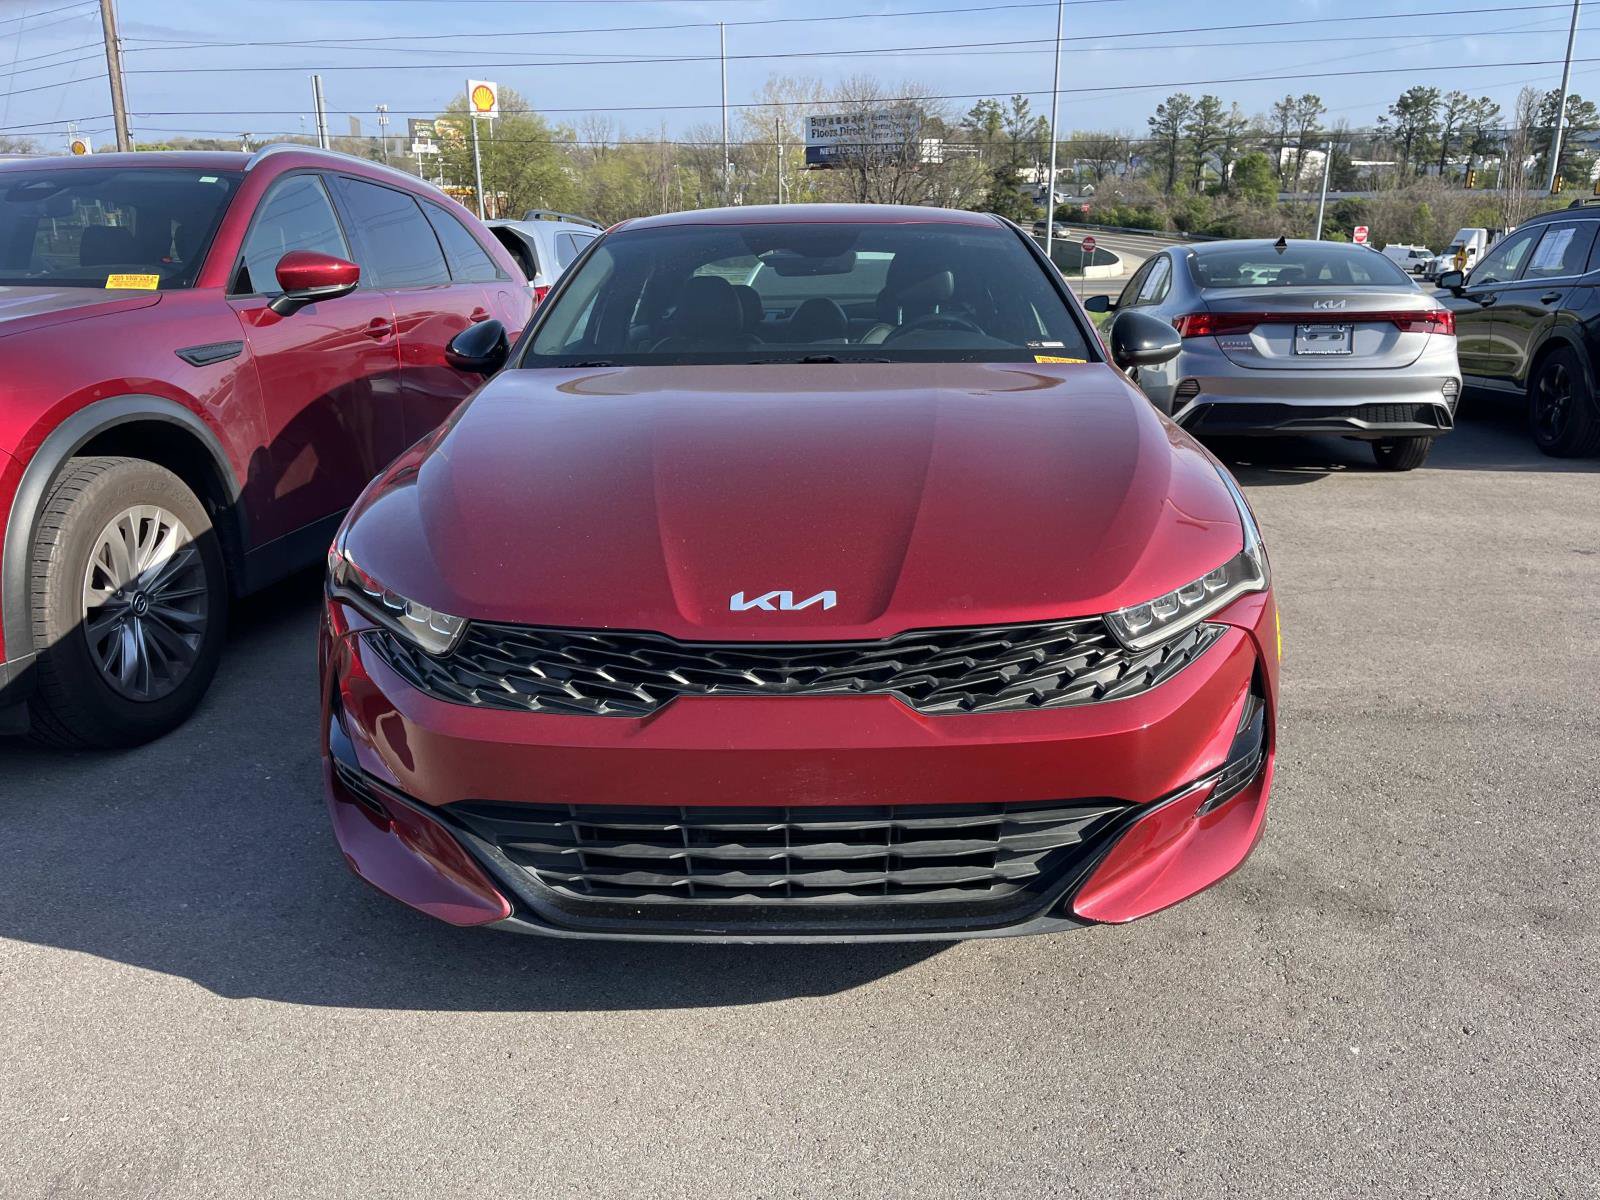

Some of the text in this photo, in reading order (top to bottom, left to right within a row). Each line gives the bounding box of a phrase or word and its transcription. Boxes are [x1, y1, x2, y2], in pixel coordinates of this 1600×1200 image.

[811, 116, 827, 128] Buy
[811, 126, 866, 138] Floors Direct
[820, 147, 836, 155] NEW
[1313, 299, 1346, 309] KIA
[729, 590, 837, 611] KIA
